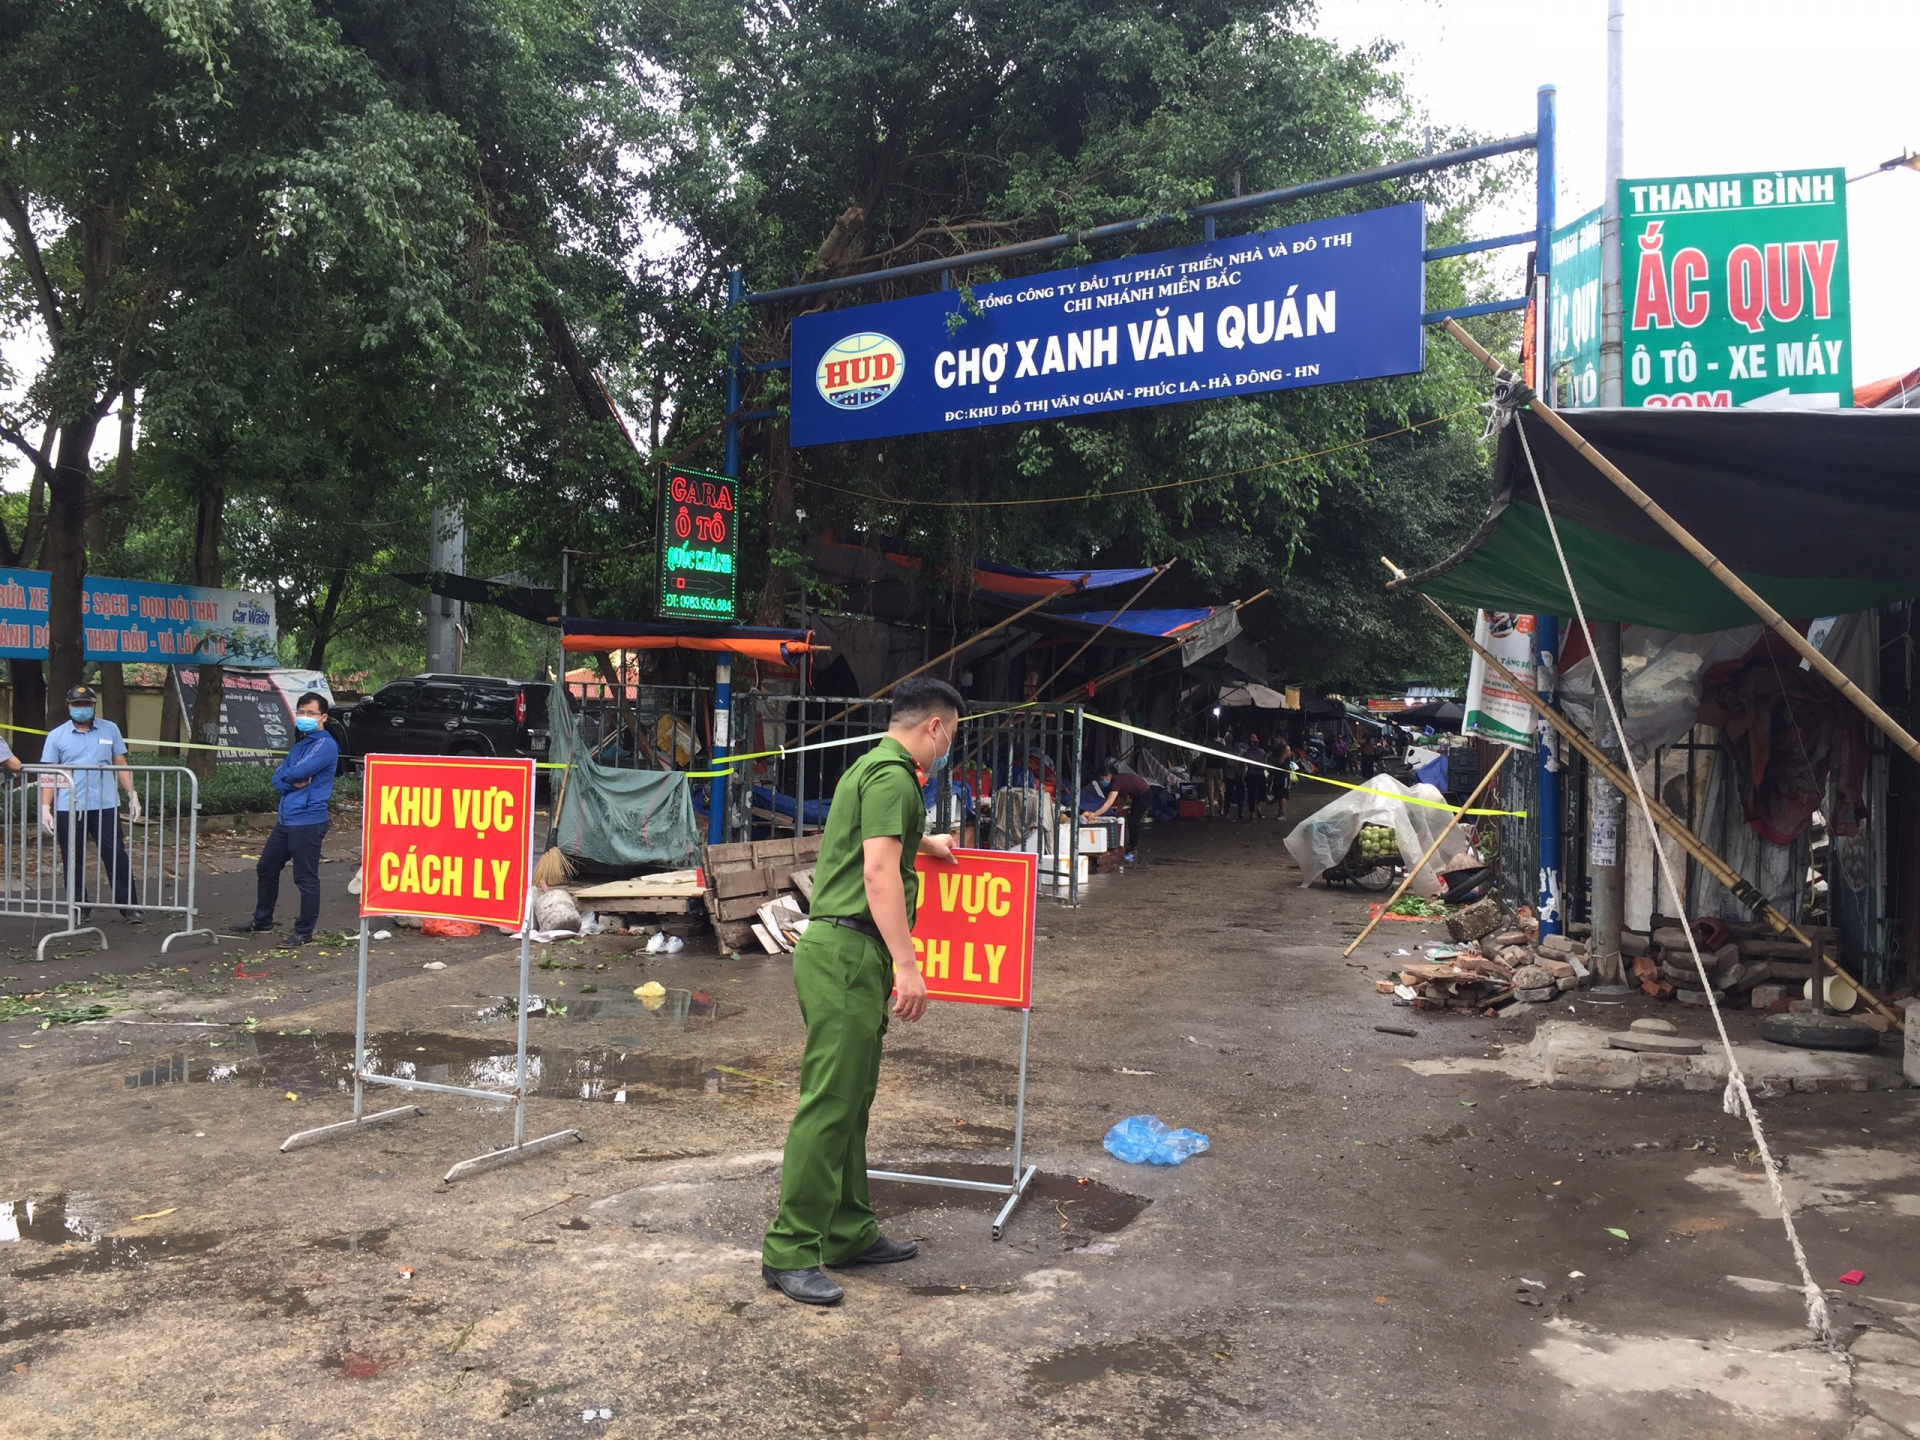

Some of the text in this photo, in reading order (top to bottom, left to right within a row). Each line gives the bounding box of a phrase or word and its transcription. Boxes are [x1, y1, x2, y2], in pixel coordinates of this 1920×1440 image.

[1629, 172, 1834, 213] THANH BÌNH
[1551, 231, 1578, 267] THANH
[977, 232, 1352, 309] TỔNG CÔNG TY ĐẦU TƯ PHÁT TRIỂN NHÀ VÀ ĐÔ THỊ
[1063, 267, 1242, 313] CHI NHÁNH MIỀN BẮC
[1631, 220, 1839, 333] ẮC QUY
[1551, 277, 1599, 357] ẮC QUY
[934, 284, 1336, 394] CHỢ XANH VĂN QUÁN
[1631, 344, 1651, 386] Ô
[1660, 342, 1697, 384] TÔ
[1728, 344, 1767, 380] XE
[1777, 333, 1843, 378] MÁY
[825, 352, 895, 389] HUD
[1001, 401, 1021, 416] ĐÔ
[1024, 399, 1048, 414] THỊ
[1051, 394, 1080, 409] VĂN
[1083, 387, 1124, 406] QUÁN
[1134, 381, 1176, 399] PHÚC
[1179, 381, 1200, 393] LA
[1208, 373, 1232, 389] HÀ
[1235, 368, 1283, 386] ĐÔNG
[1295, 363, 1320, 378] HN
[671, 476, 733, 511] GARA
[675, 506, 726, 543] Ô TÔ
[28, 586, 49, 611] XE
[93, 592, 129, 620] SẠCH
[139, 595, 166, 623] DỌN
[168, 595, 190, 624] NỘI
[191, 596, 219, 622] THẤT
[232, 609, 270, 625] Car Wash
[0, 618, 30, 648] ÁNH
[84, 628, 118, 651] THAY
[157, 628, 175, 654] VÁ
[380, 785, 514, 840] KHU VỰC
[379, 844, 511, 901] CÁCH LY
[938, 872, 1012, 923] VỰC
[962, 942, 1007, 984] LY
